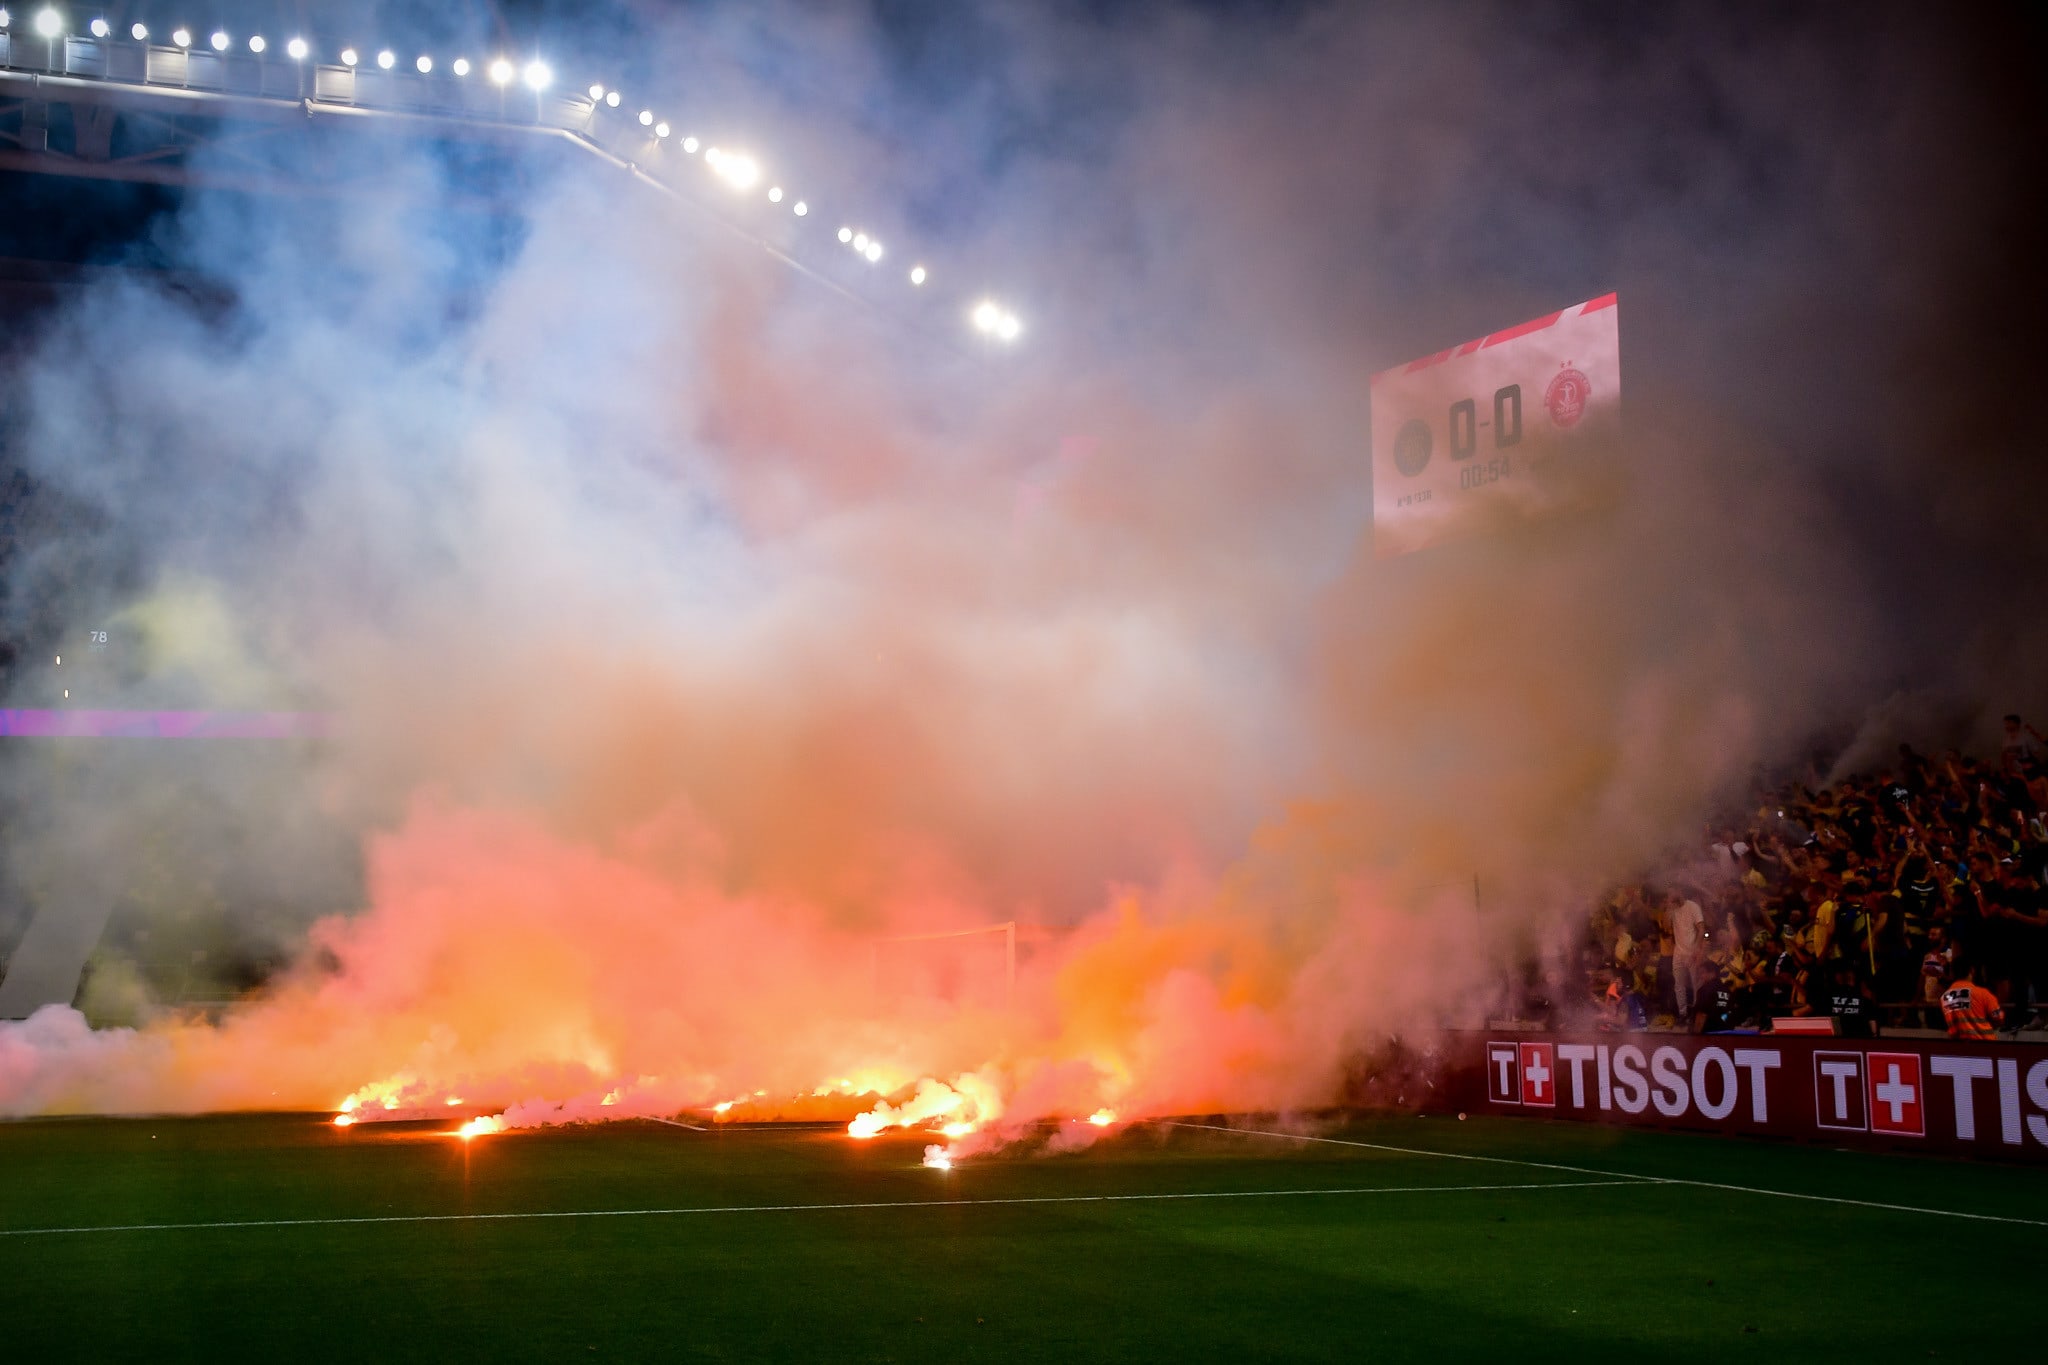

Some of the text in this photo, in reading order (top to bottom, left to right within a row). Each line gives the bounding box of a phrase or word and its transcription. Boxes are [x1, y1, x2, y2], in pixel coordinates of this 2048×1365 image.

[1461, 456, 1511, 490] 00:54
[90, 631, 107, 643] 78
[1558, 1044, 1781, 1123] TISSOT
